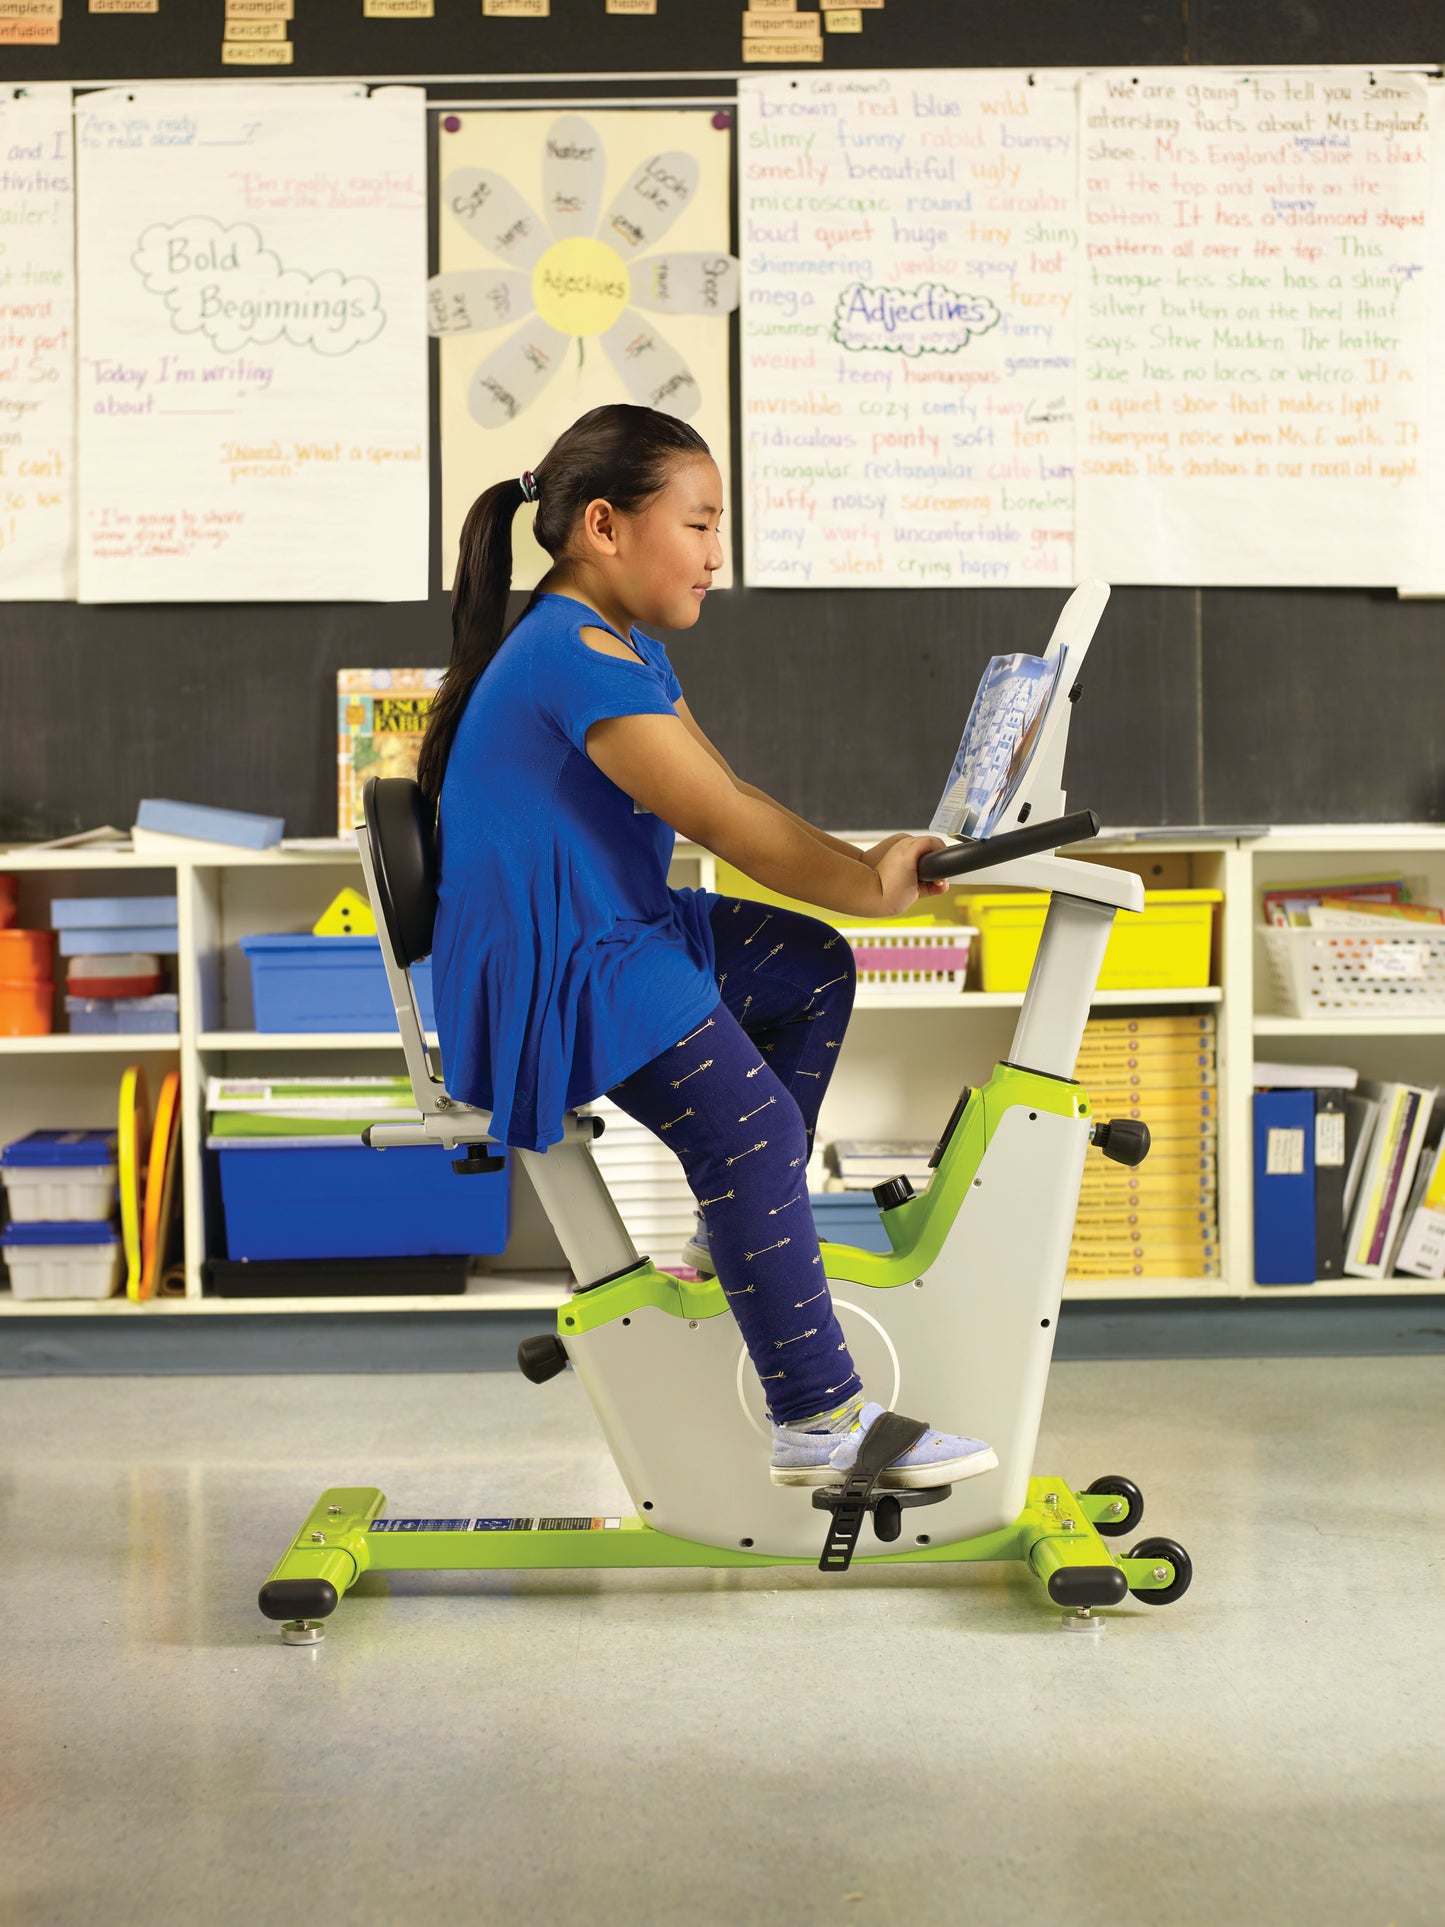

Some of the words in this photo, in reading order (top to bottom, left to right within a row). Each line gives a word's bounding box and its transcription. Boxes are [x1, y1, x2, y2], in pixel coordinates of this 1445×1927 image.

[230, 22, 280, 37] except
[750, 18, 816, 30] important
[227, 44, 288, 61] exciting
[759, 91, 837, 118] brown
[858, 97, 898, 116] red
[913, 91, 961, 117] blue
[980, 90, 1028, 116] wild
[1106, 80, 1135, 100] We
[1142, 85, 1176, 100] are
[1186, 83, 1239, 110] going
[1253, 80, 1275, 101] to
[1284, 80, 1314, 101] tell
[1322, 87, 1352, 105] you
[1362, 87, 1408, 100] some
[1087, 106, 1180, 137] interesting
[1195, 110, 1247, 132] facts
[1257, 114, 1315, 133] about
[7, 143, 42, 160] and
[51, 131, 67, 160] I
[749, 125, 816, 157] slimy
[837, 118, 905, 153] funny
[921, 126, 984, 148] rabid
[1001, 123, 1071, 155] bumpy
[748, 156, 828, 185] smelly
[845, 151, 955, 181] beautiful
[971, 153, 1021, 189] ugly
[1208, 141, 1301, 172] England's
[1312, 149, 1353, 164] shoe
[1366, 145, 1381, 164] is
[1386, 144, 1428, 164] black
[750, 195, 890, 213] microscopic
[907, 192, 972, 212] round
[988, 188, 1067, 211] circular
[1087, 177, 1110, 191] on
[1127, 171, 1160, 193] the
[1173, 172, 1208, 200] top
[1216, 178, 1253, 194] and
[1264, 175, 1315, 194] white
[1322, 182, 1343, 195] on
[1353, 176, 1381, 194] the
[1172, 200, 1203, 227] It
[1216, 202, 1252, 227] has
[1261, 213, 1275, 226] a
[1284, 208, 1367, 227] diamond
[1376, 210, 1425, 230] shaped
[748, 219, 799, 243] loud
[815, 219, 874, 250] quiet
[892, 218, 948, 251] huge
[969, 221, 1011, 247] tiny
[1086, 237, 1163, 262] pattern
[1172, 240, 1194, 258] all
[1203, 245, 1240, 258] over
[1253, 239, 1281, 257] the
[1334, 235, 1384, 257] This
[168, 238, 240, 273] Bold
[748, 252, 873, 281] shimmering
[889, 255, 956, 282] jumbo
[966, 259, 1017, 280] spicy
[1031, 250, 1068, 273] hot
[543, 269, 625, 299] Adjectives
[1227, 266, 1272, 290] shoe
[1284, 266, 1314, 290] has
[1328, 274, 1342, 290] a
[1352, 268, 1405, 300] shiny
[200, 284, 365, 332] Beginnings
[749, 289, 814, 316] mega
[847, 287, 985, 331] Adjectives
[1008, 281, 1072, 316] fuzzy
[1089, 294, 1147, 318] silver
[1161, 297, 1228, 320] button
[1236, 306, 1259, 320] on
[1270, 302, 1299, 320] the
[1309, 301, 1342, 320] heel
[1357, 298, 1398, 320] that
[1086, 334, 1137, 356] says
[1150, 324, 1202, 349] Steve
[1297, 327, 1329, 350] The
[1339, 328, 1401, 351] leather
[154, 356, 195, 383] I'm
[202, 358, 273, 389] writing
[751, 348, 816, 369] weird
[838, 356, 893, 392] teeny
[1086, 360, 1129, 383] shoe
[1143, 359, 1174, 381] has
[1183, 366, 1206, 381] no
[1215, 359, 1261, 382] laces
[1270, 370, 1288, 382] or
[1364, 357, 1389, 384] It
[94, 394, 154, 415] about
[748, 390, 842, 415] invisible
[859, 400, 909, 421] cozy
[923, 395, 976, 422] comfy
[986, 395, 1023, 416] two
[1086, 397, 1100, 412] a
[1109, 391, 1161, 420] quiet
[1172, 392, 1218, 414] shoe
[1230, 391, 1267, 415] that
[1279, 391, 1334, 413] makes
[1342, 392, 1382, 423] light
[751, 426, 856, 448] ridiculous
[872, 425, 939, 457] pointy
[953, 426, 995, 447] soft
[1012, 419, 1049, 448] ten
[1179, 430, 1224, 446] noise
[1394, 421, 1418, 445] It
[864, 456, 976, 489] rectangular
[988, 456, 1031, 479] cute
[832, 495, 886, 520] noisy
[901, 495, 991, 519] screaming
[823, 523, 880, 548] warty
[895, 520, 1020, 543] uncomfortable
[829, 551, 883, 574] silent
[897, 561, 951, 579] crying
[960, 551, 1009, 578] happy
[1022, 552, 1058, 573] cold
